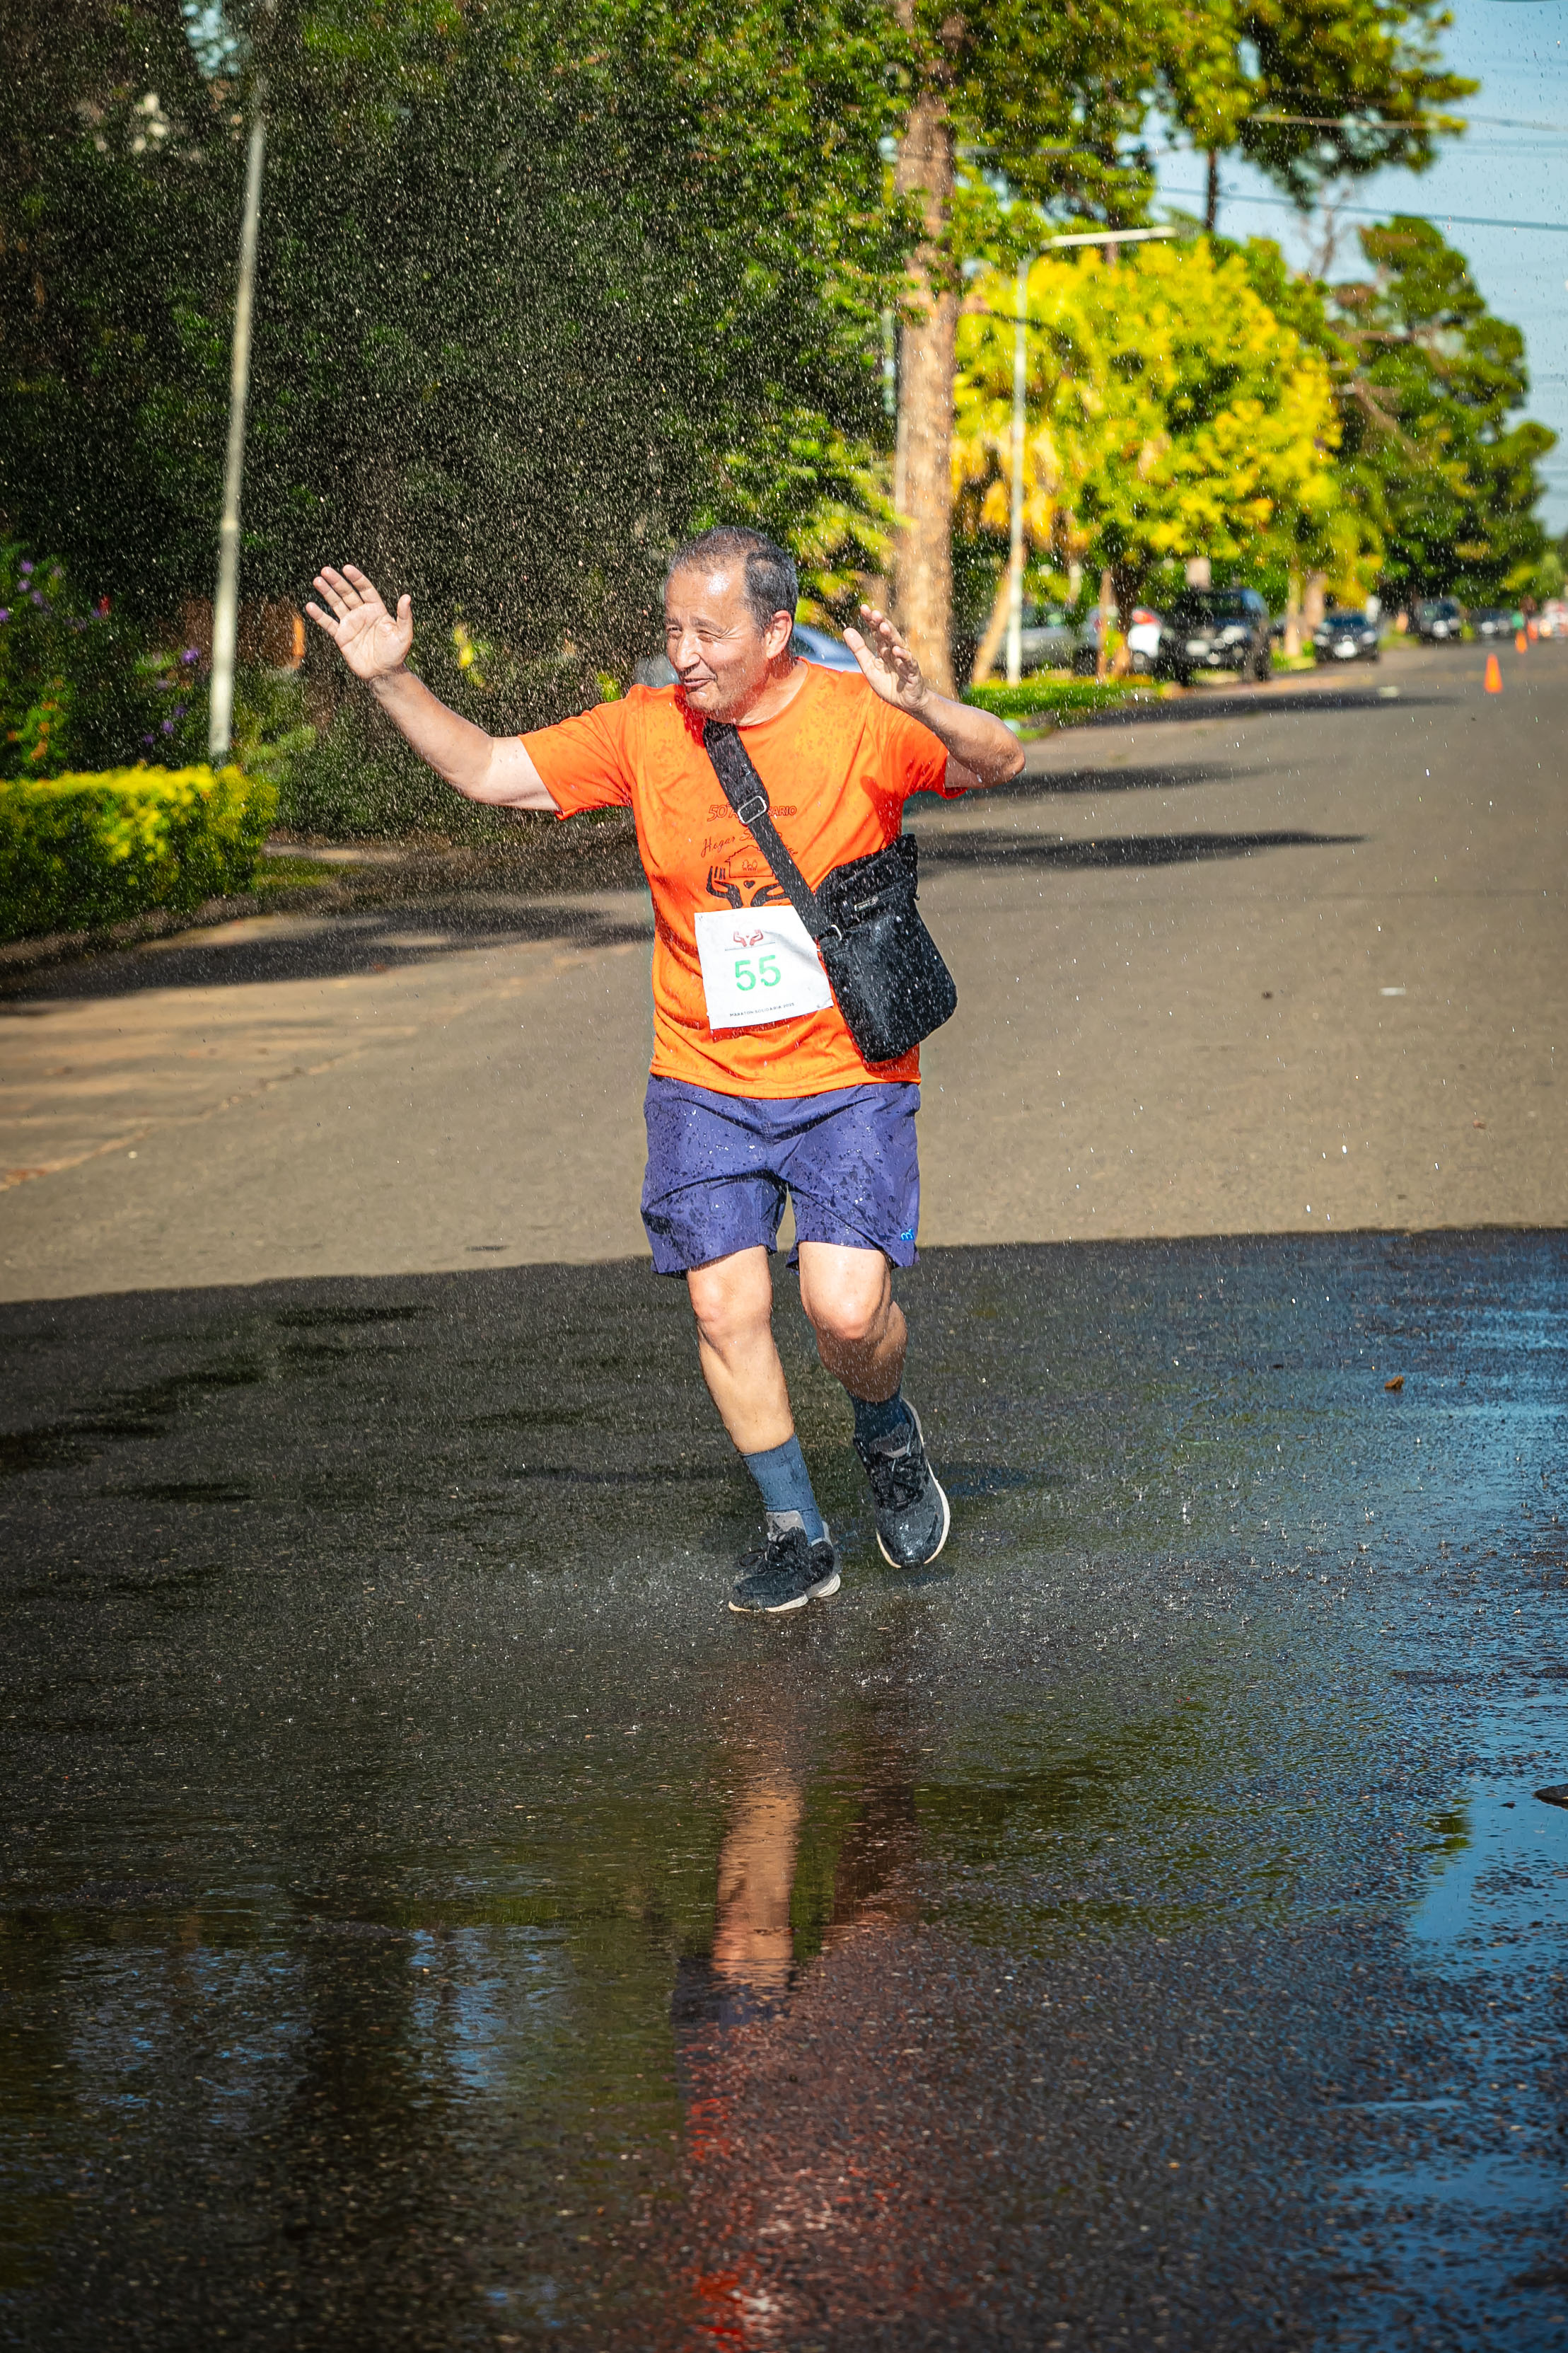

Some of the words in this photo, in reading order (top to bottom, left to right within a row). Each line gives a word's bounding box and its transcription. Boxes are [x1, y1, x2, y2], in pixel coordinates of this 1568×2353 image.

[728, 804, 798, 818] ASARIO
[701, 836, 736, 858] Hogar
[735, 954, 781, 991] 55
[755, 1005, 782, 1014] SOLIDARIA
